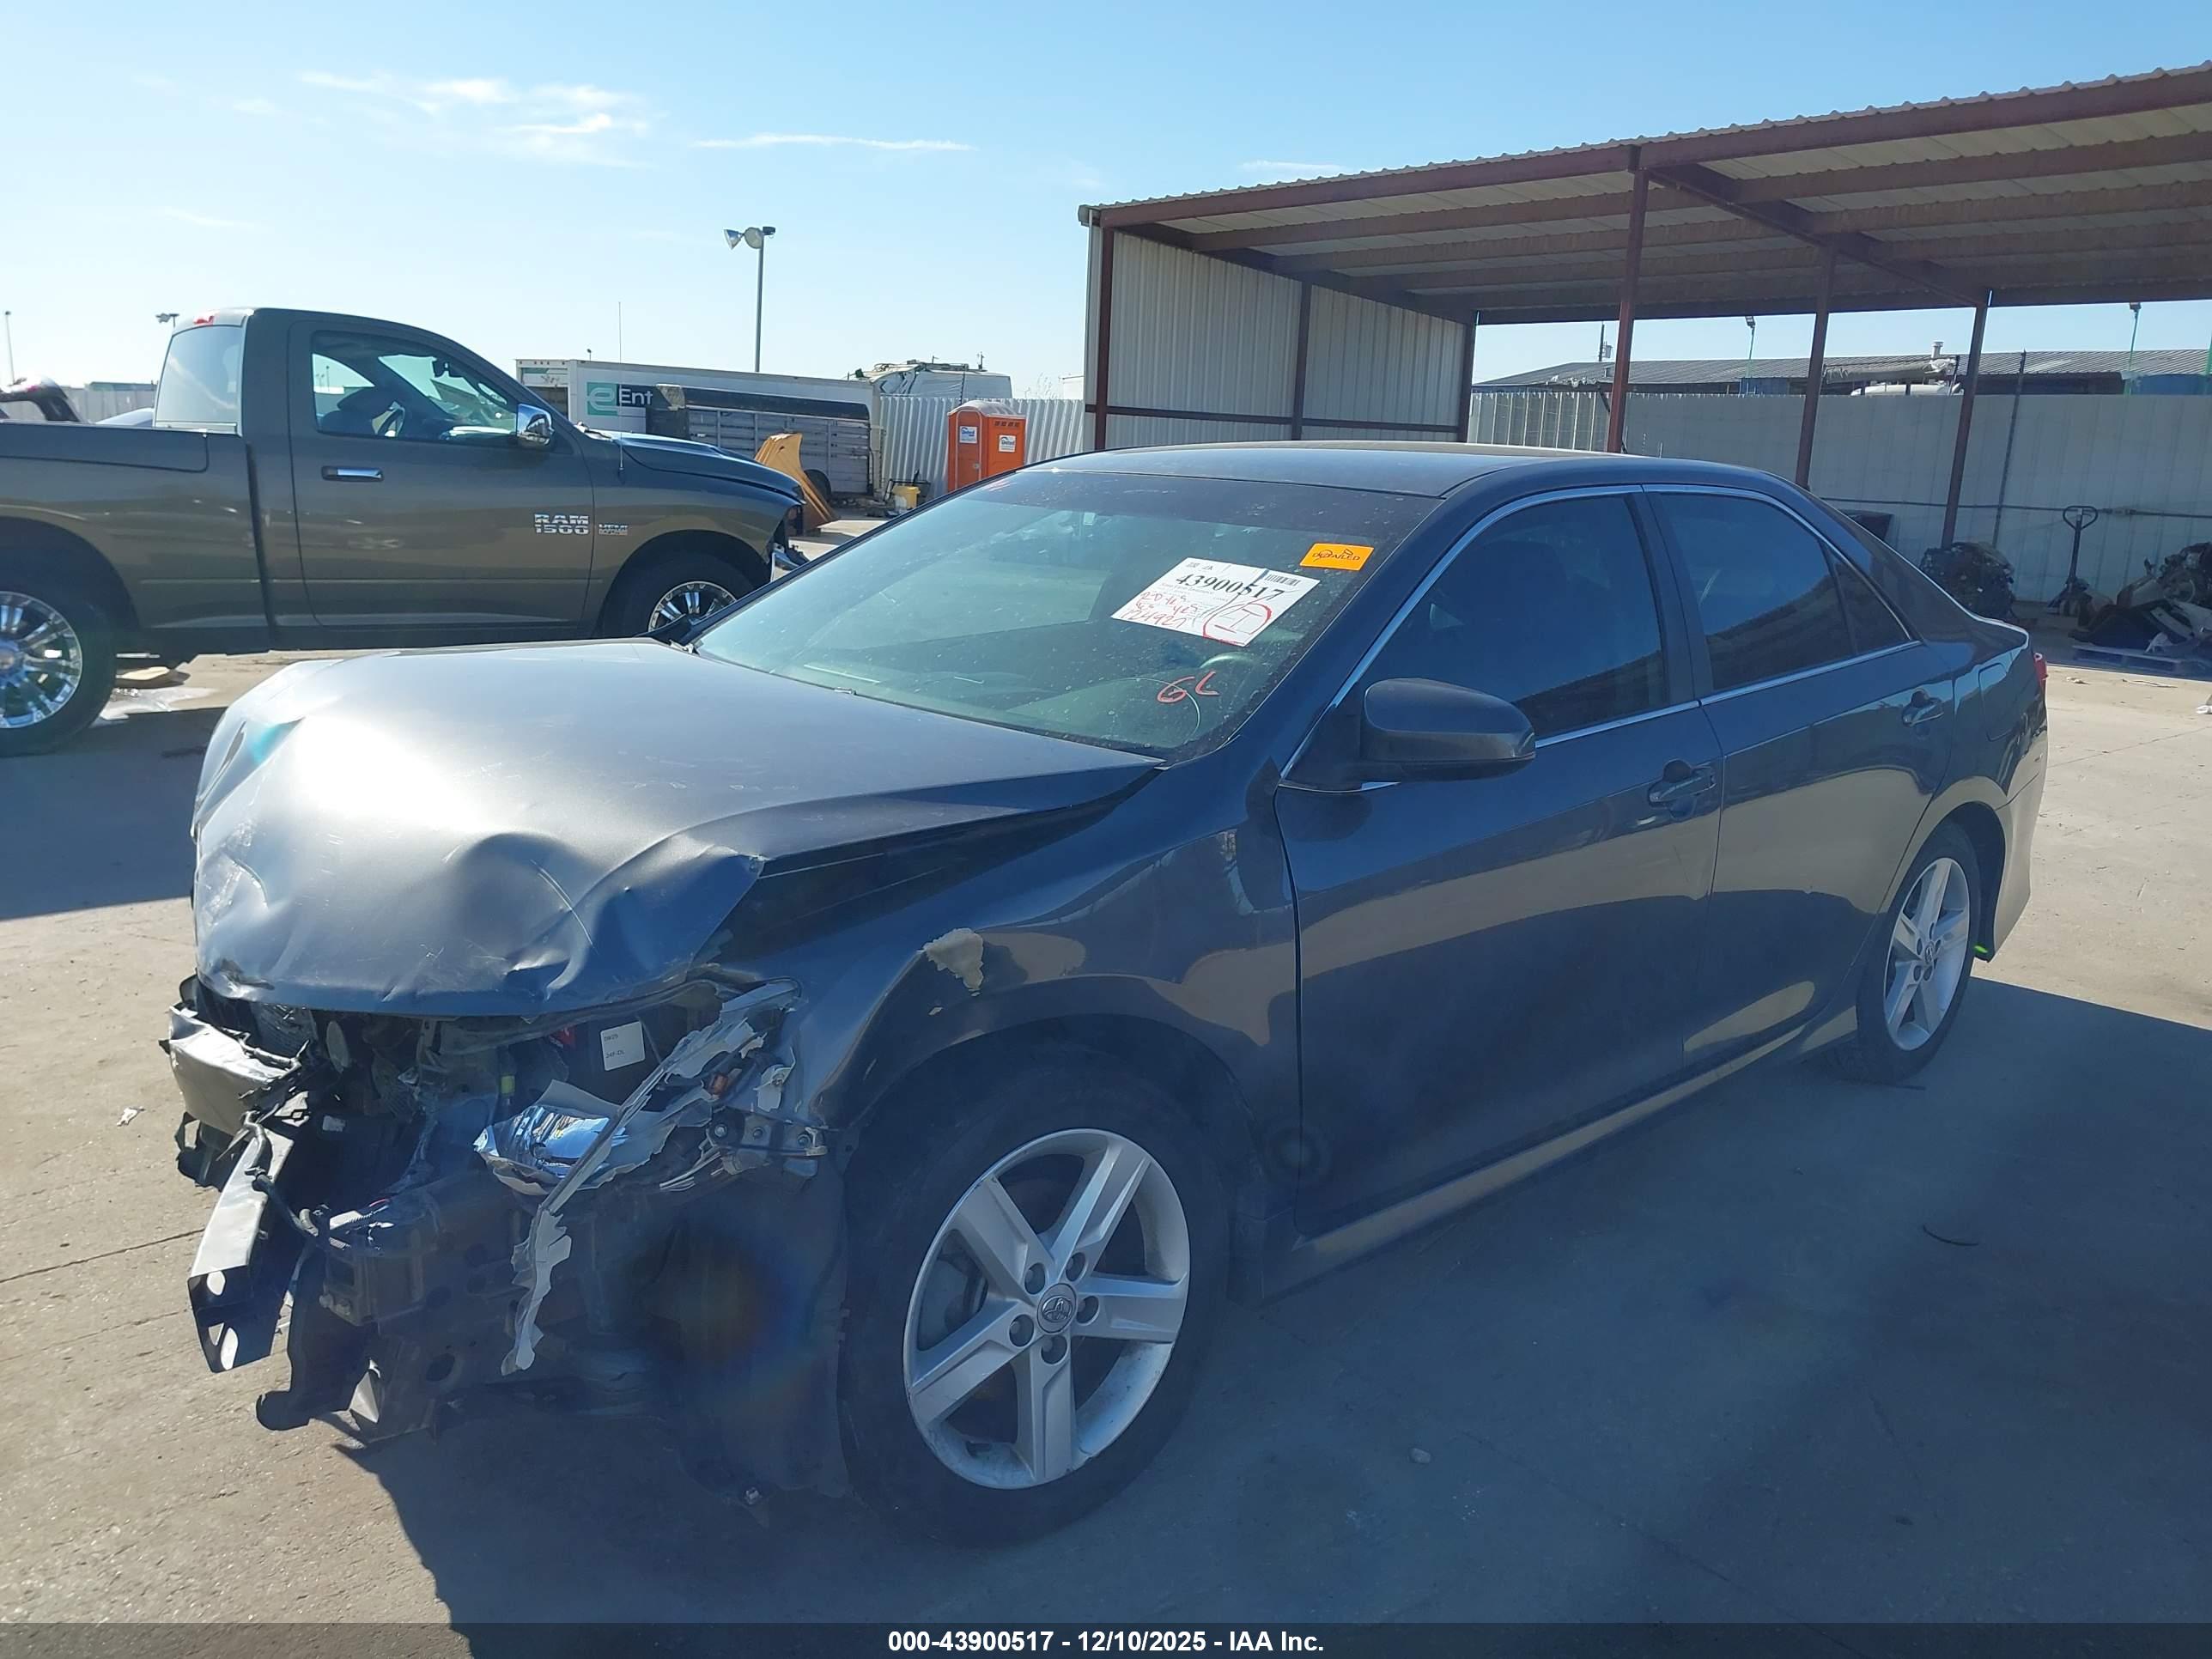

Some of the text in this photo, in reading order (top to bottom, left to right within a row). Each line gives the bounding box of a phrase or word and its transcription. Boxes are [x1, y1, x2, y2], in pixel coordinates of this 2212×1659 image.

[534, 514, 589, 525] RAM
[534, 524, 589, 535] 1500
[1176, 574, 1285, 601] 43900517
